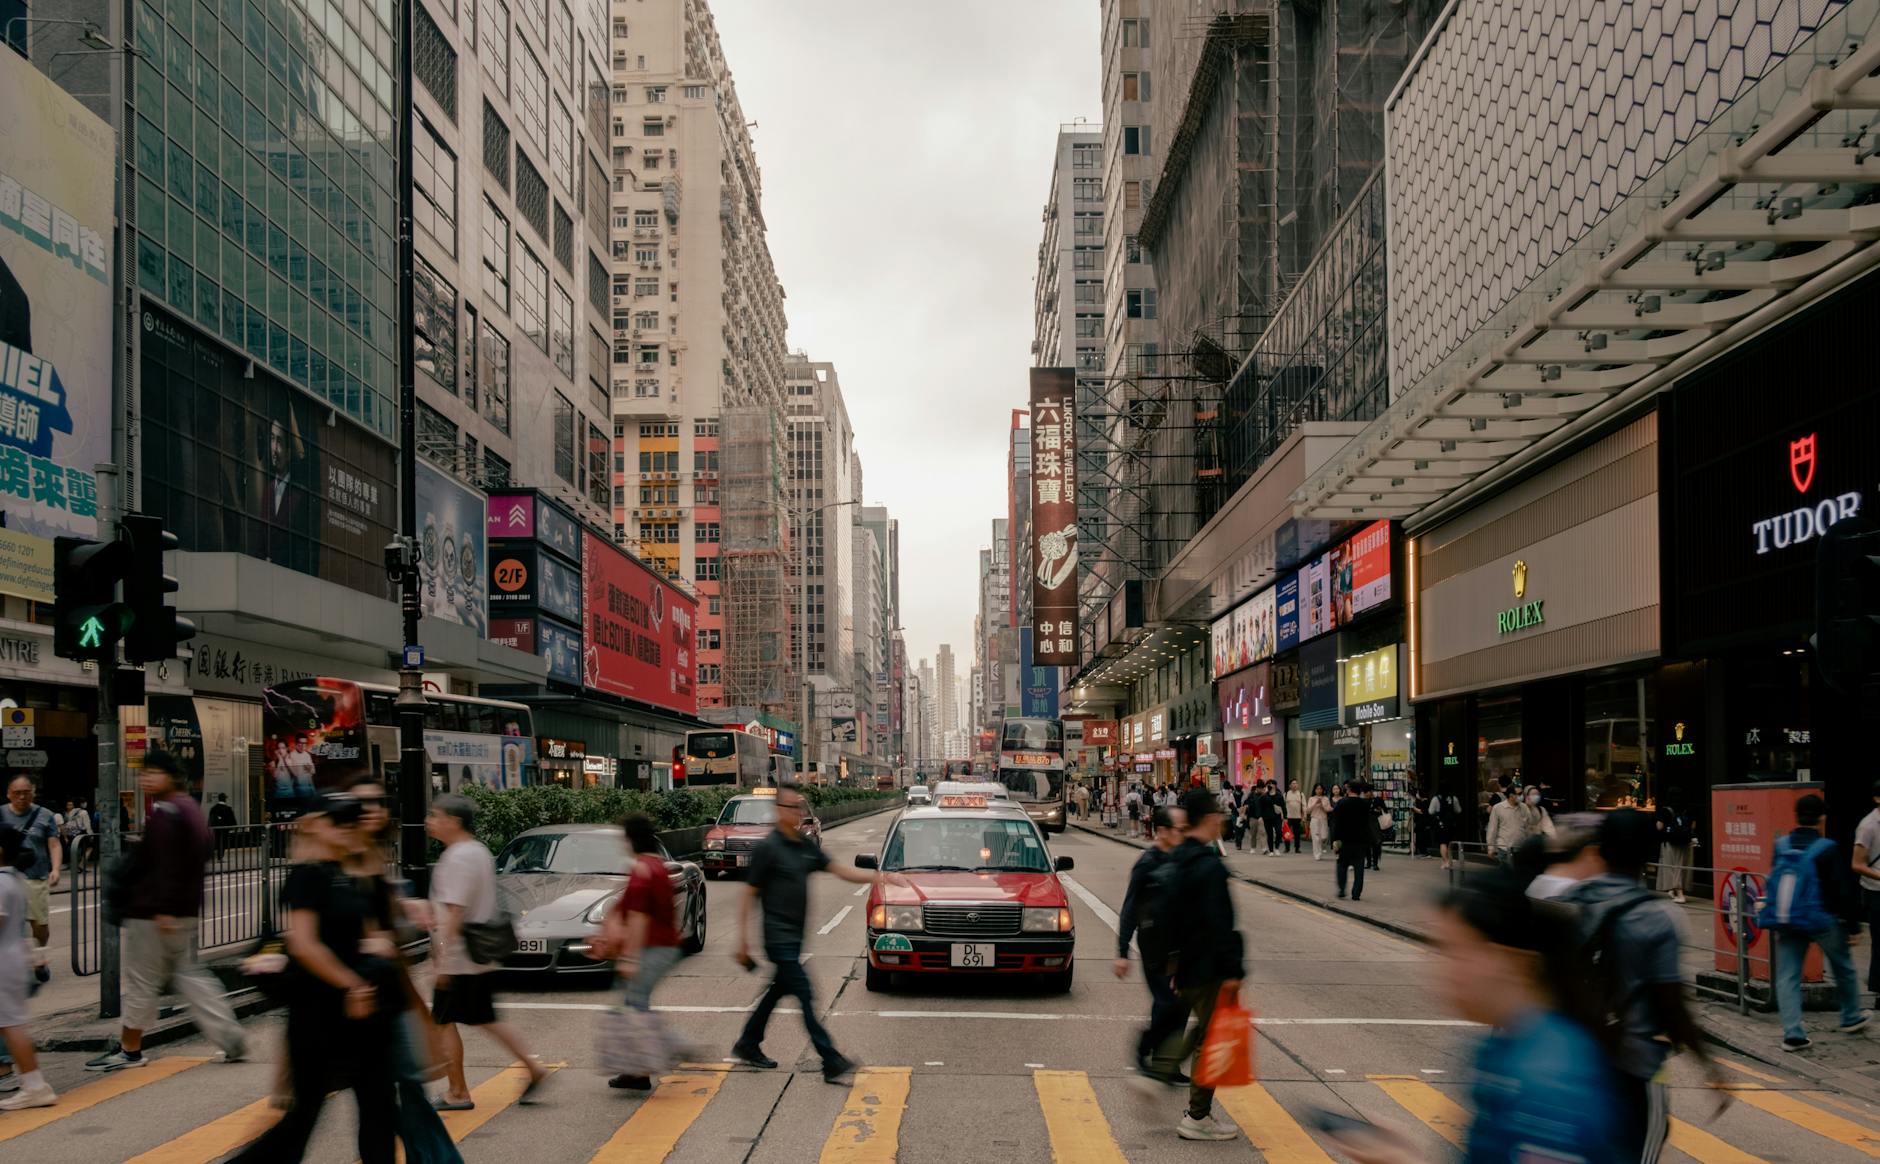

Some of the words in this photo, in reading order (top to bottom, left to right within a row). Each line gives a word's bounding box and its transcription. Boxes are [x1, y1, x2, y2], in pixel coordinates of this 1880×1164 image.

[0, 341, 60, 406] IEL
[1035, 397, 1062, 505] 六福珠寶
[1063, 445, 1074, 504] JEWELLERY
[1752, 491, 1863, 555] TUDOR
[499, 568, 523, 583] 2/F
[1498, 600, 1544, 634] ROLEX
[517, 623, 529, 633] 1/F
[1355, 704, 1374, 721] Mobile
[1666, 742, 1696, 756] ROLEX
[944, 796, 985, 806] TAXI
[519, 940, 543, 952] 891
[963, 944, 982, 956] DL
[962, 955, 984, 966] 691
